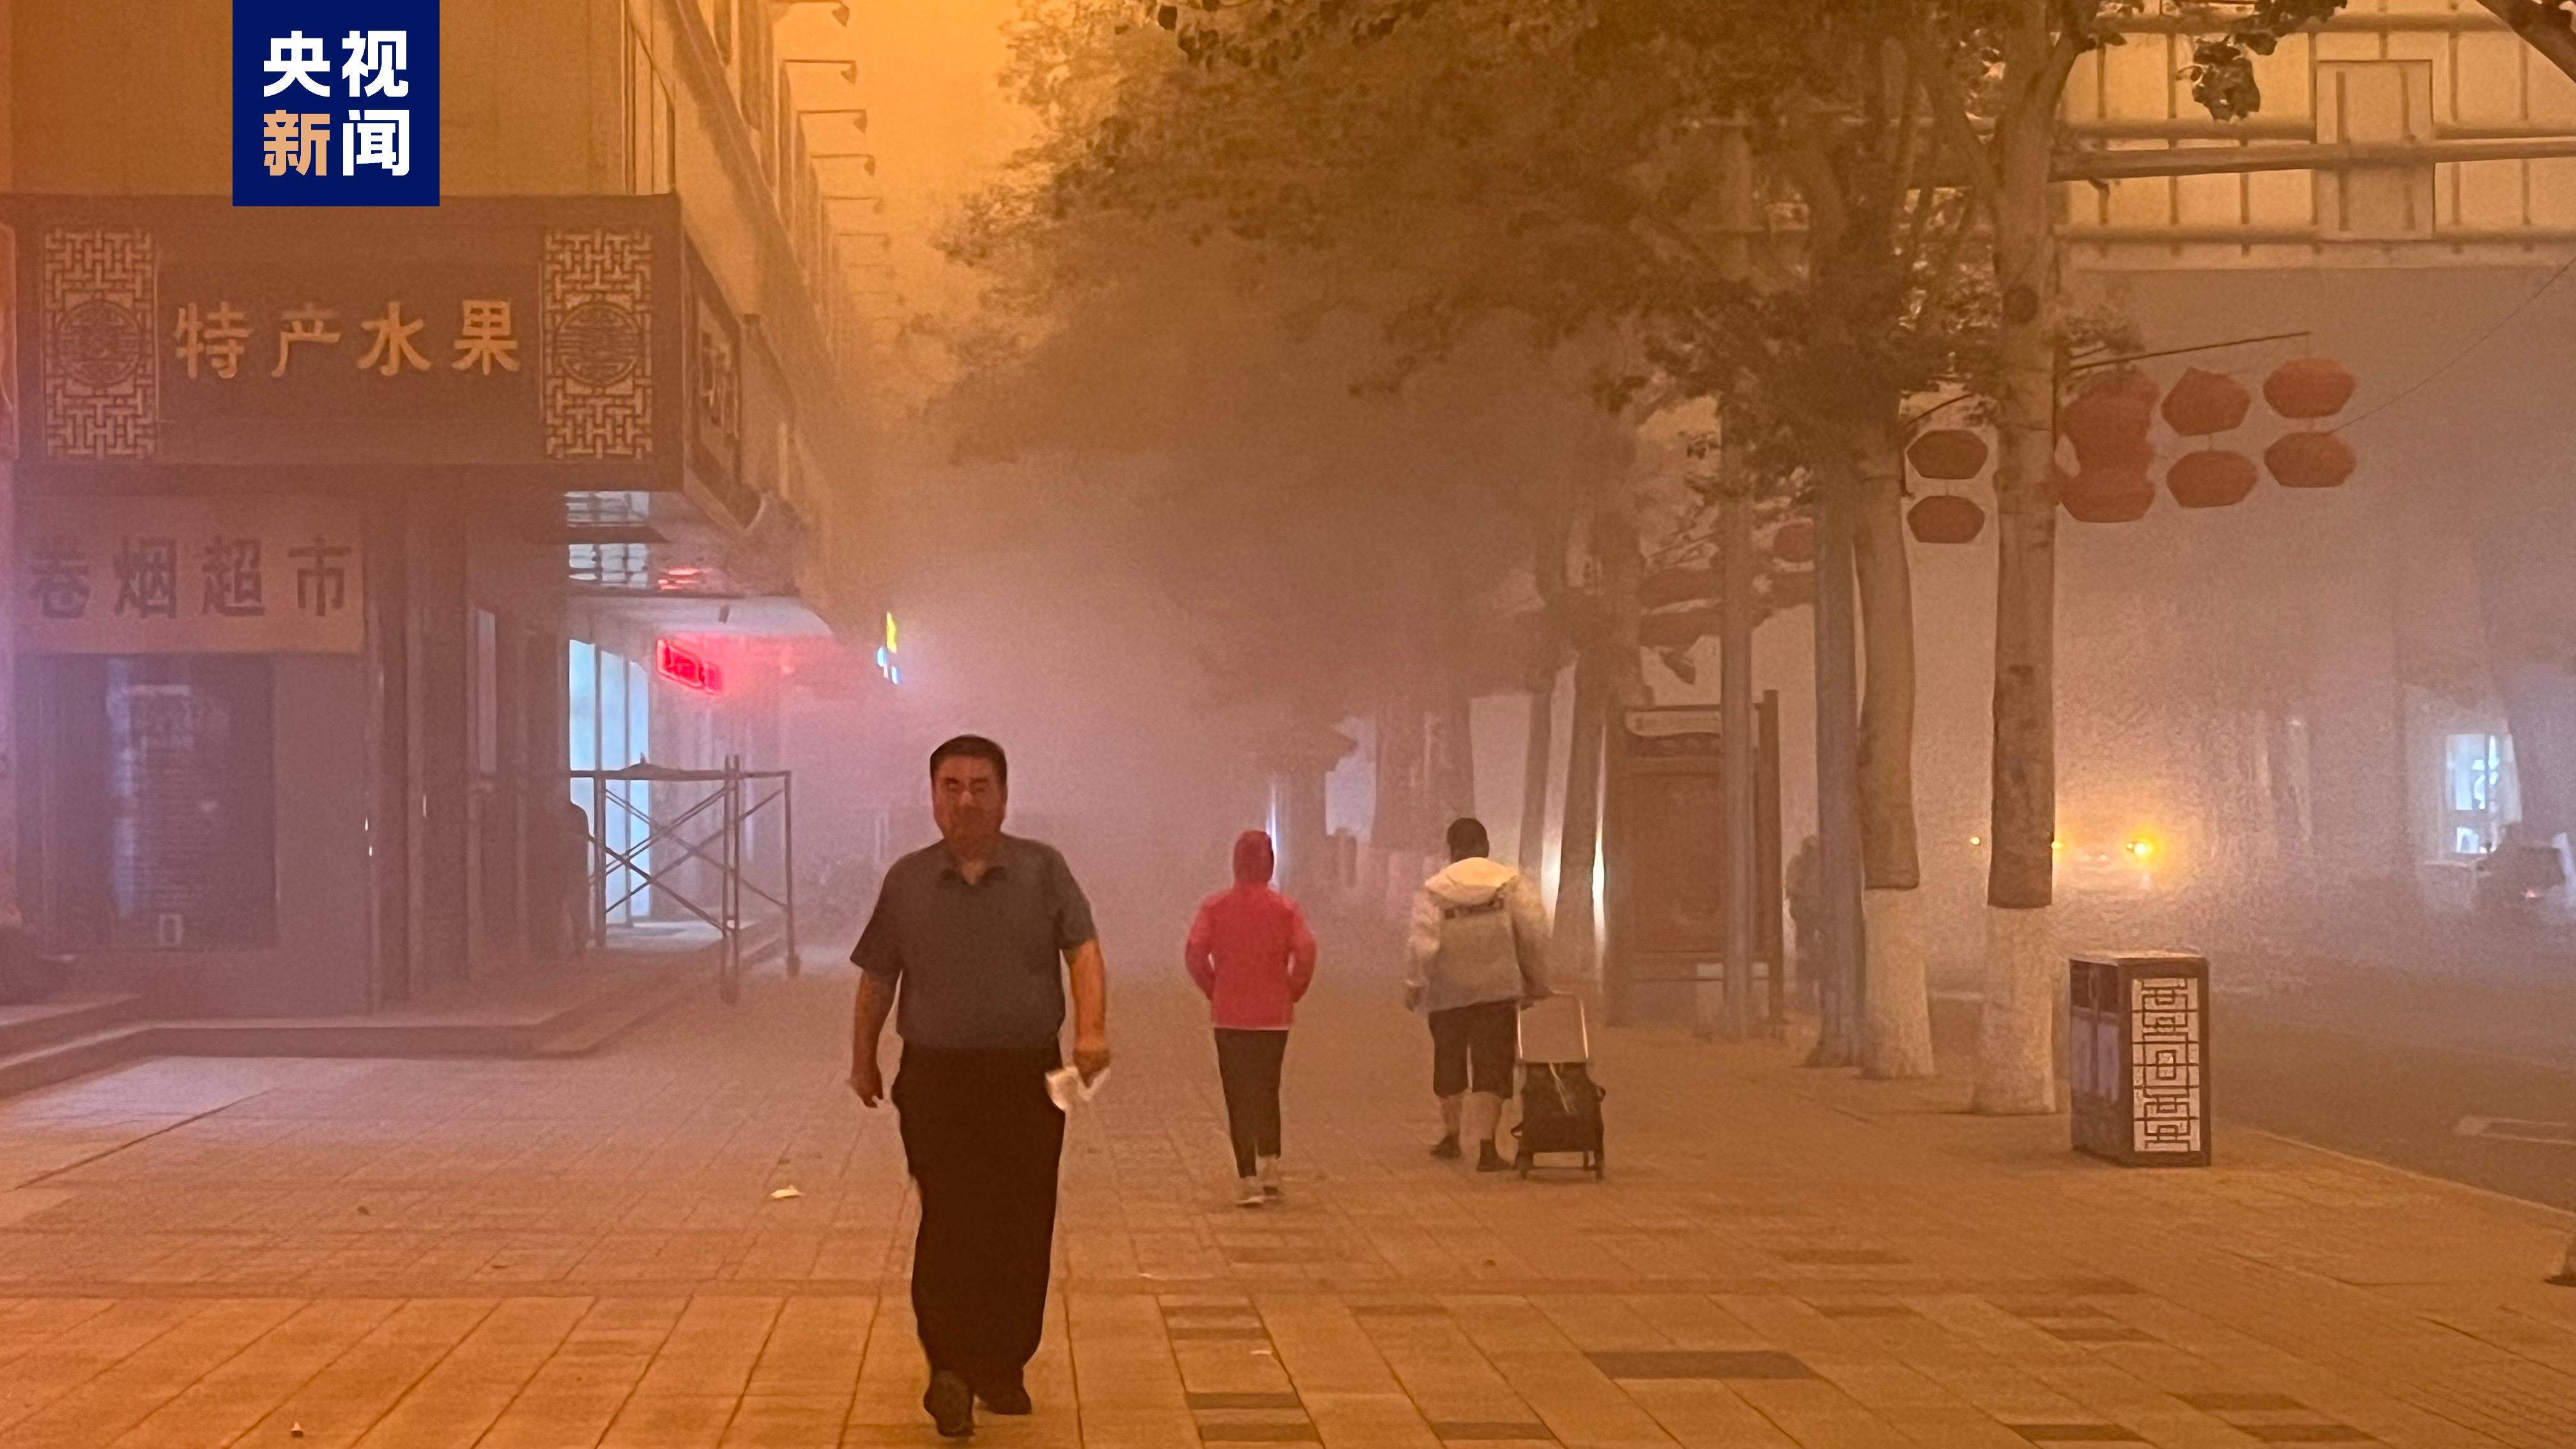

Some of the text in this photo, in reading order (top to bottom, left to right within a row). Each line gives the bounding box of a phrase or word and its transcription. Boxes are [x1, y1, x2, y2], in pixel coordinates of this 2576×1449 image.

[174, 300, 521, 379] 特产水果
[28, 535, 351, 619] 卷烟超市
